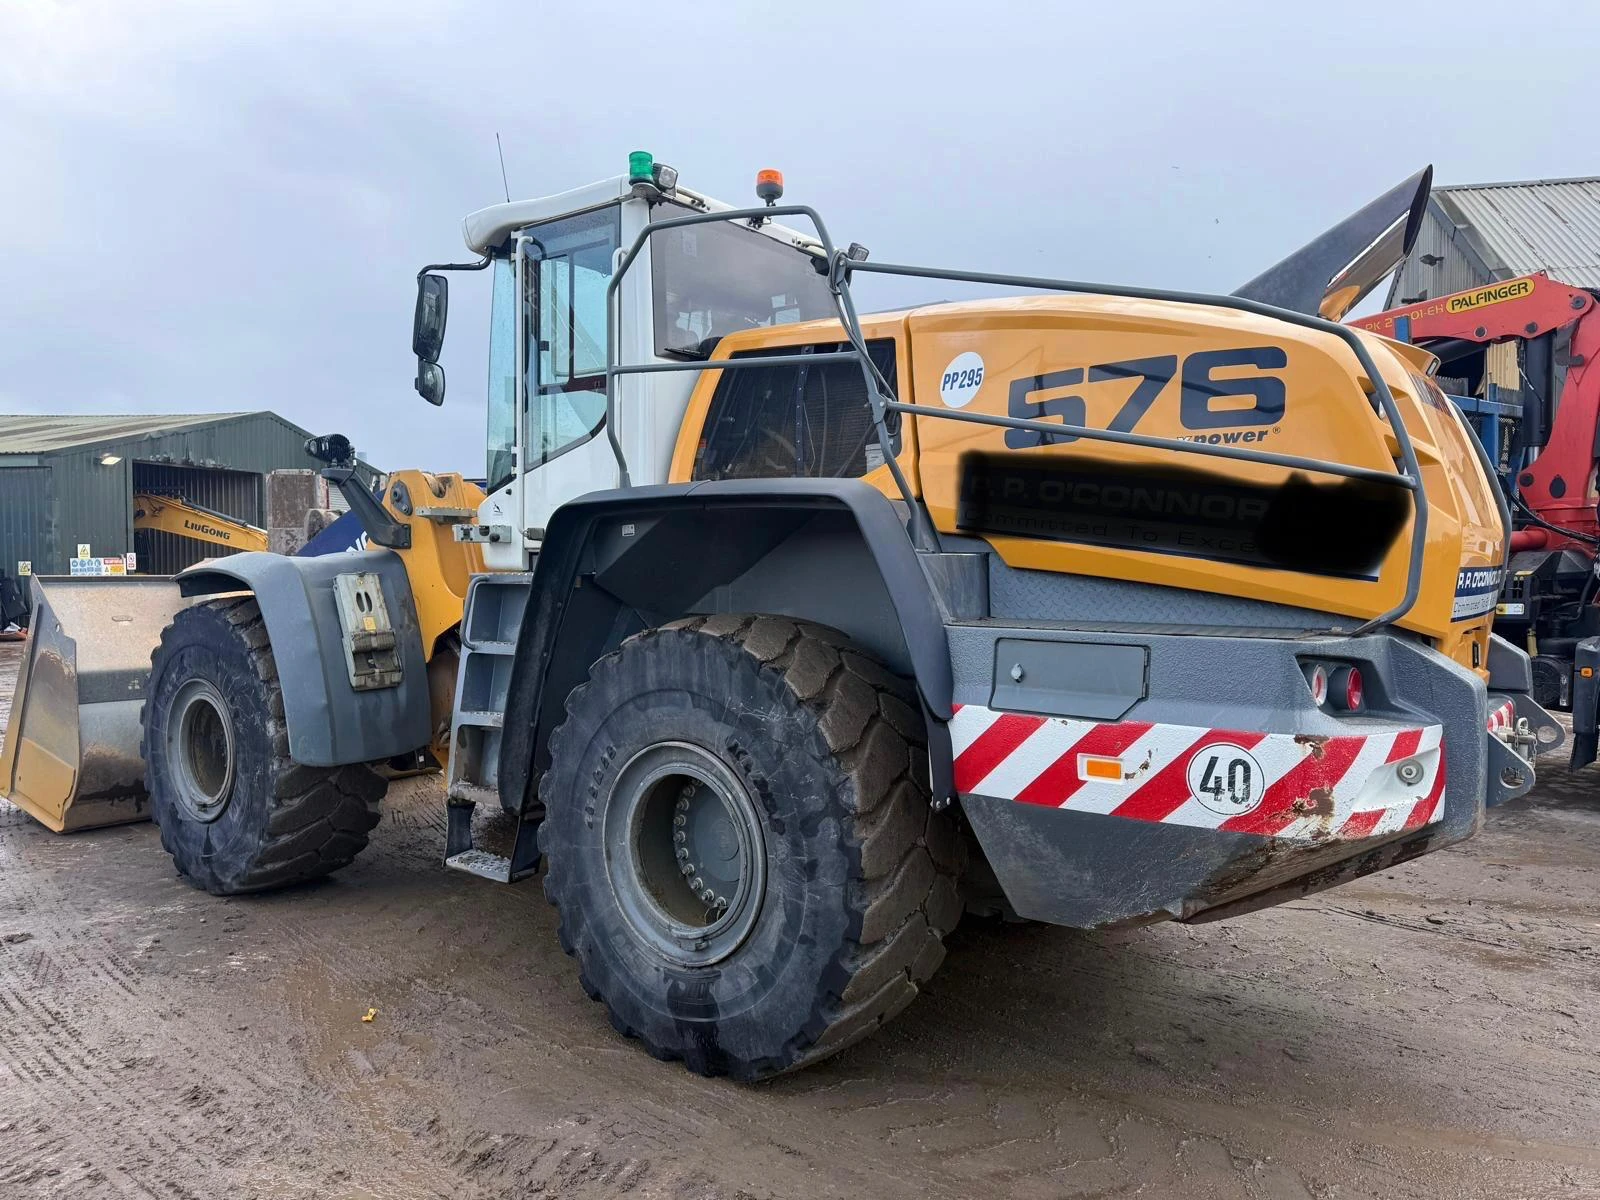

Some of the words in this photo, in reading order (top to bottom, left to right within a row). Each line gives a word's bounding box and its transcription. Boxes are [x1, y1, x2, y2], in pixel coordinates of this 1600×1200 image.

[1451, 281, 1528, 310] PALFINGER
[1385, 304, 1444, 328] 201-EH
[942, 367, 983, 391] PP295
[1004, 346, 1287, 449] 576
[1002, 477, 1029, 500] P.
[1200, 756, 1251, 804] 40
